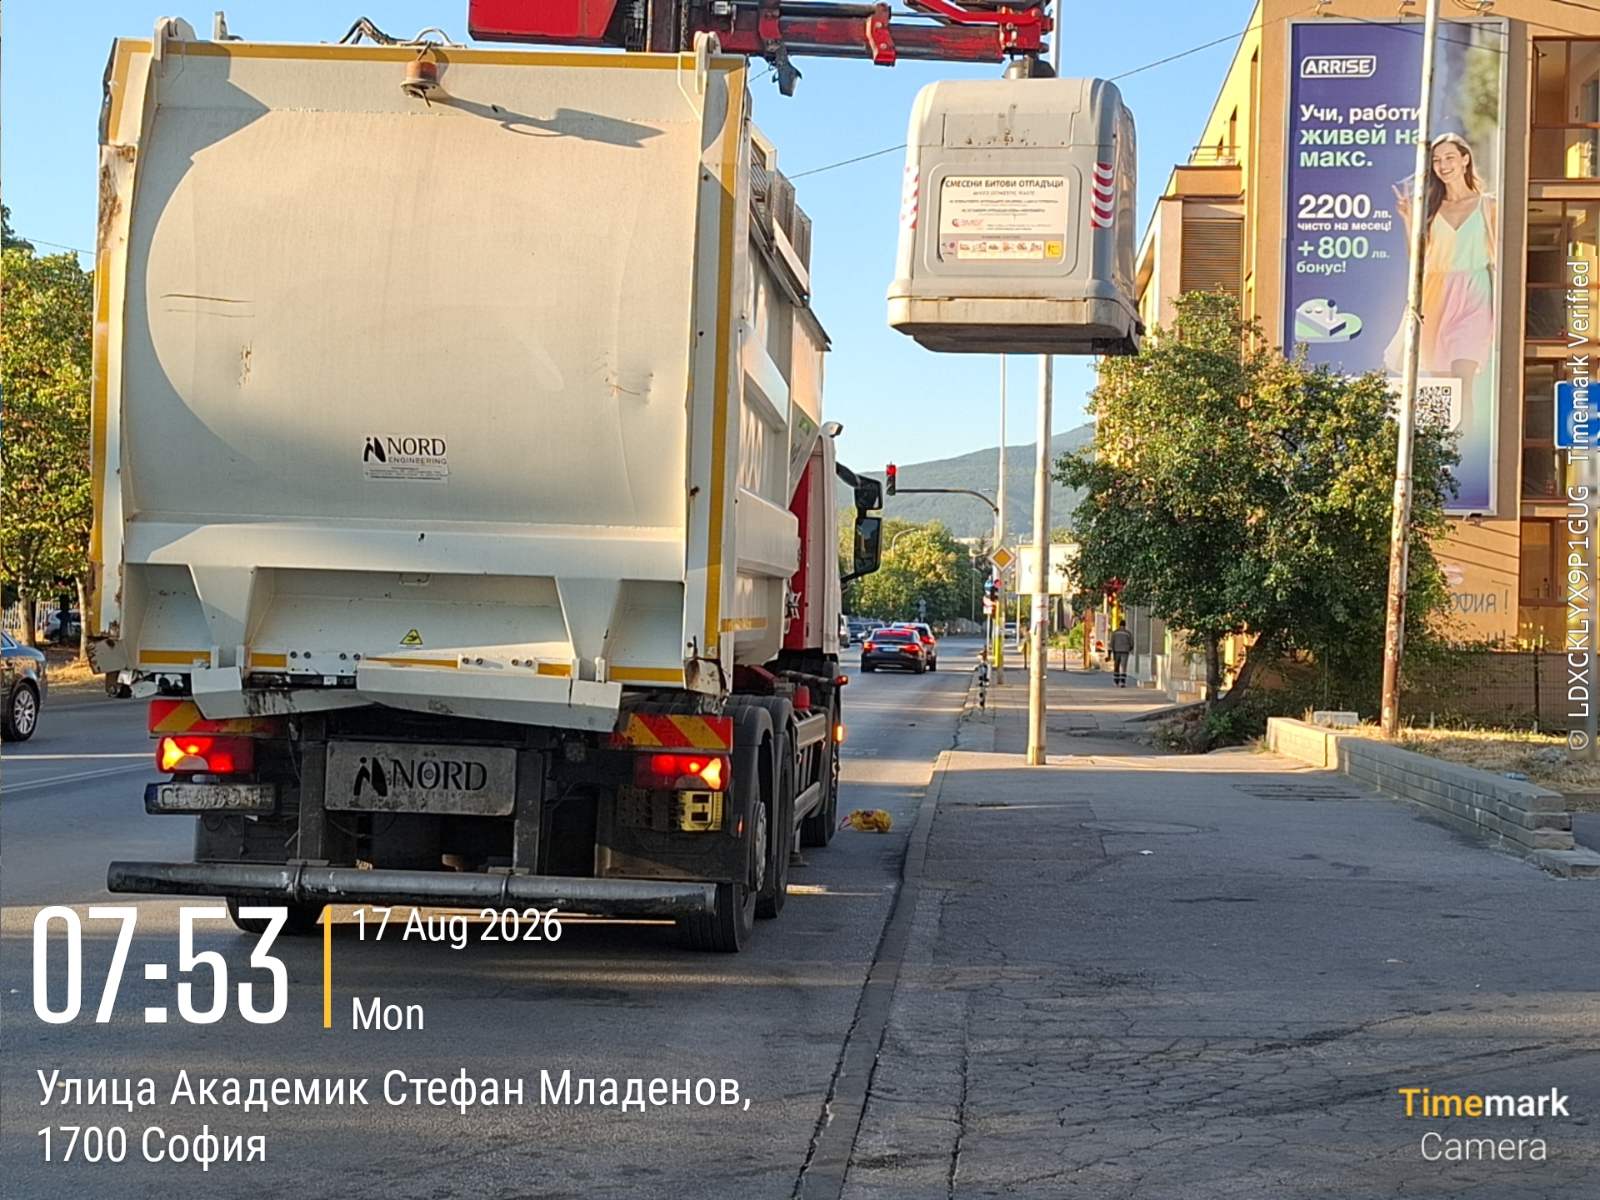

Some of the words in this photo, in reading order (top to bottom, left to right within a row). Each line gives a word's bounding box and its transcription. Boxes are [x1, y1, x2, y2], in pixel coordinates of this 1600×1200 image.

[1305, 59, 1371, 74] ARRISE
[1300, 104, 1343, 124] Учи,
[1300, 123, 1387, 145] живей
[1300, 151, 1373, 167] макс.
[945, 180, 982, 188] СМЕСЕНИ
[985, 180, 1017, 188] БИТОВИ
[1019, 180, 1064, 189] ОТПАДЪЦИ
[1298, 194, 1371, 219] 2200
[1373, 210, 1392, 218] лв.
[1297, 222, 1331, 231] чисто
[1334, 222, 1349, 231] на
[1351, 221, 1392, 232] месец!
[1371, 250, 1390, 258] лв.
[1296, 261, 1346, 275] бонус!
[387, 437, 446, 456] NORD
[388, 456, 447, 464] ENGINEERING
[1449, 591, 1497, 613] ОФИЯ
[390, 757, 488, 791] NORD
